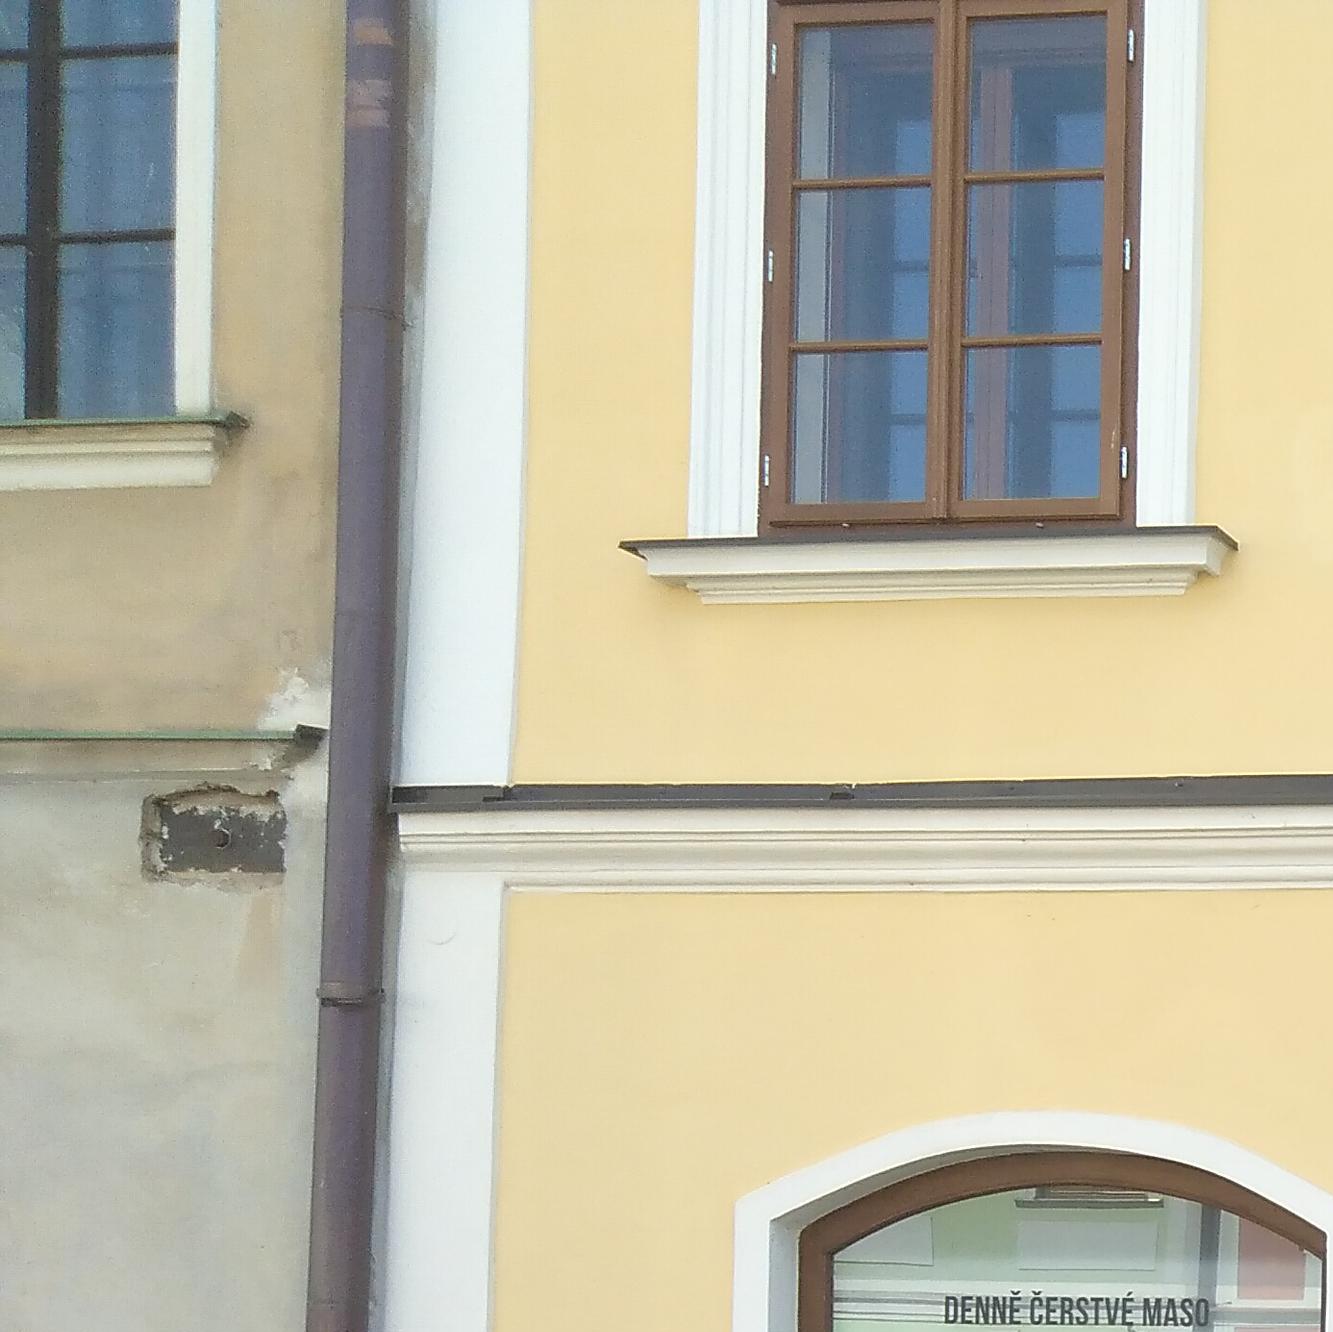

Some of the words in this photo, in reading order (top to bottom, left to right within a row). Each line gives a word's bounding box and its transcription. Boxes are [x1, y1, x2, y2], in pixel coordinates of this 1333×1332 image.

[944, 1290, 1022, 1325] DENNĚ
[1029, 1290, 1134, 1326] ČERSTVÉ
[1142, 1297, 1210, 1327] MASO
